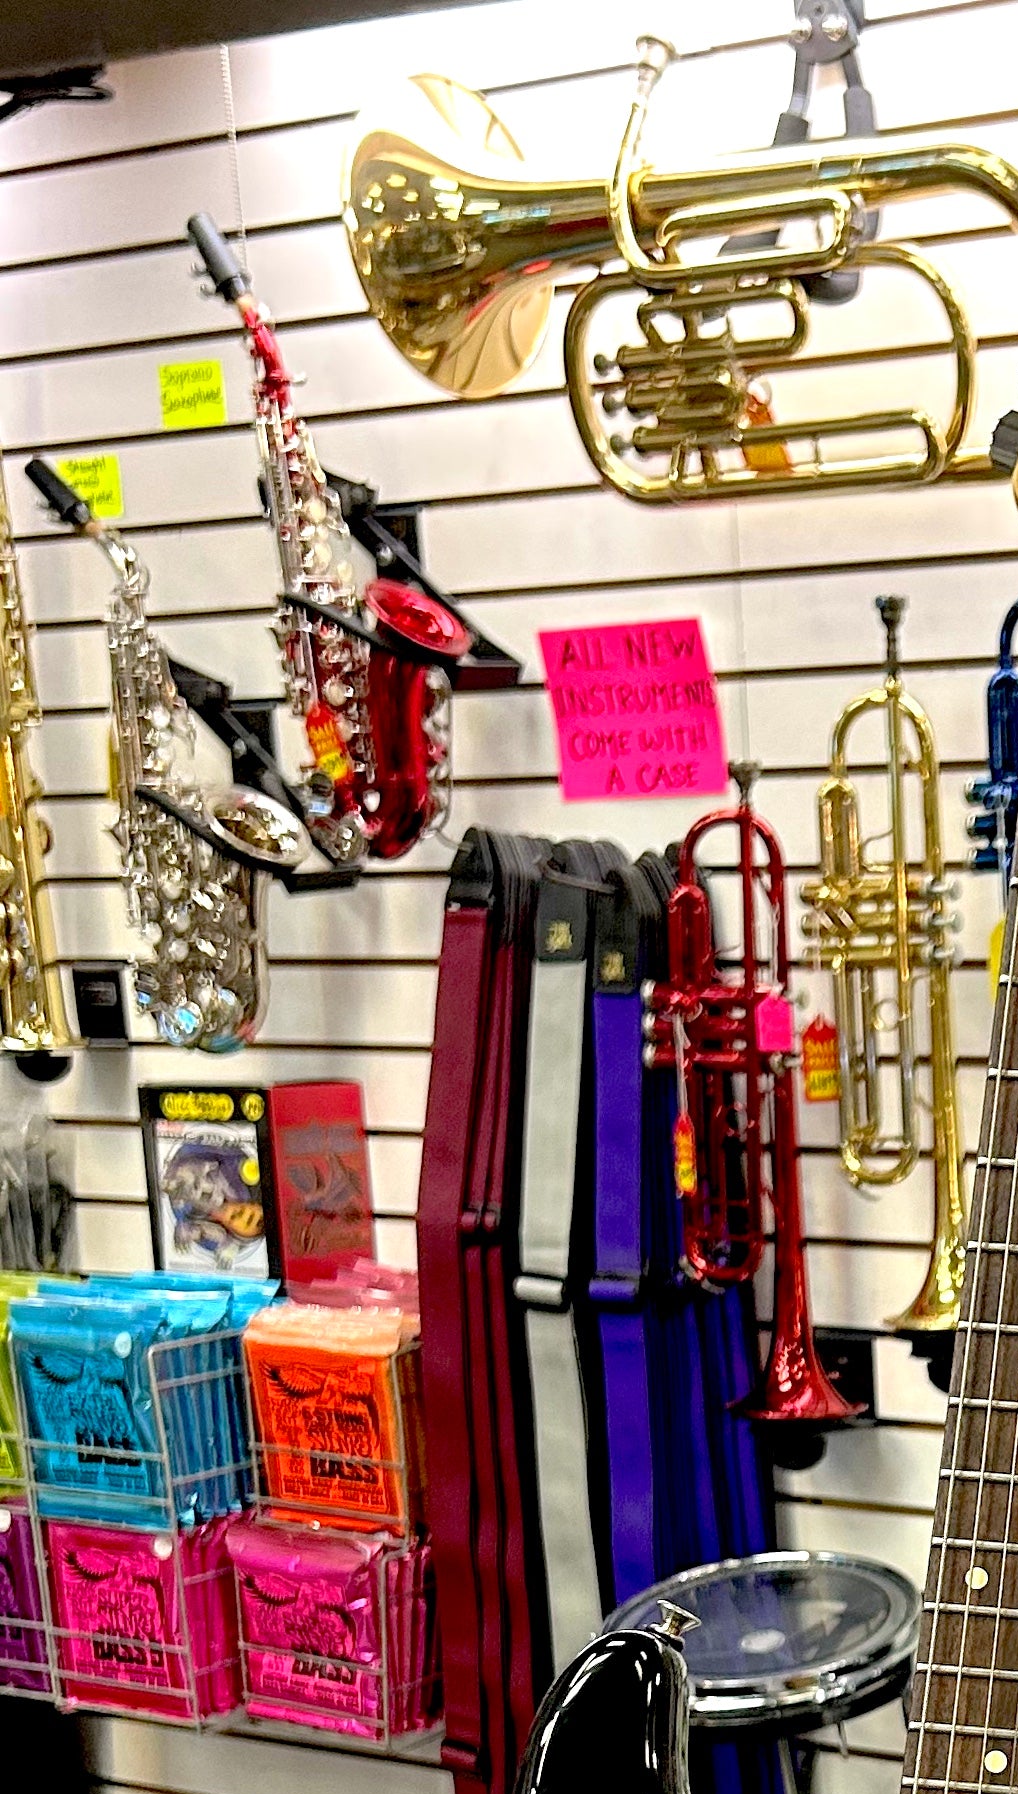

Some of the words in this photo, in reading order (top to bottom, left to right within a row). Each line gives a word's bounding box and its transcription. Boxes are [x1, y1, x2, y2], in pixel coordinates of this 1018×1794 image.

[561, 636, 613, 671] ALL
[624, 628, 697, 668] NEW
[567, 727, 630, 762] COME
[637, 722, 708, 754] WITH
[605, 763, 626, 794] A
[634, 761, 700, 793] CASE
